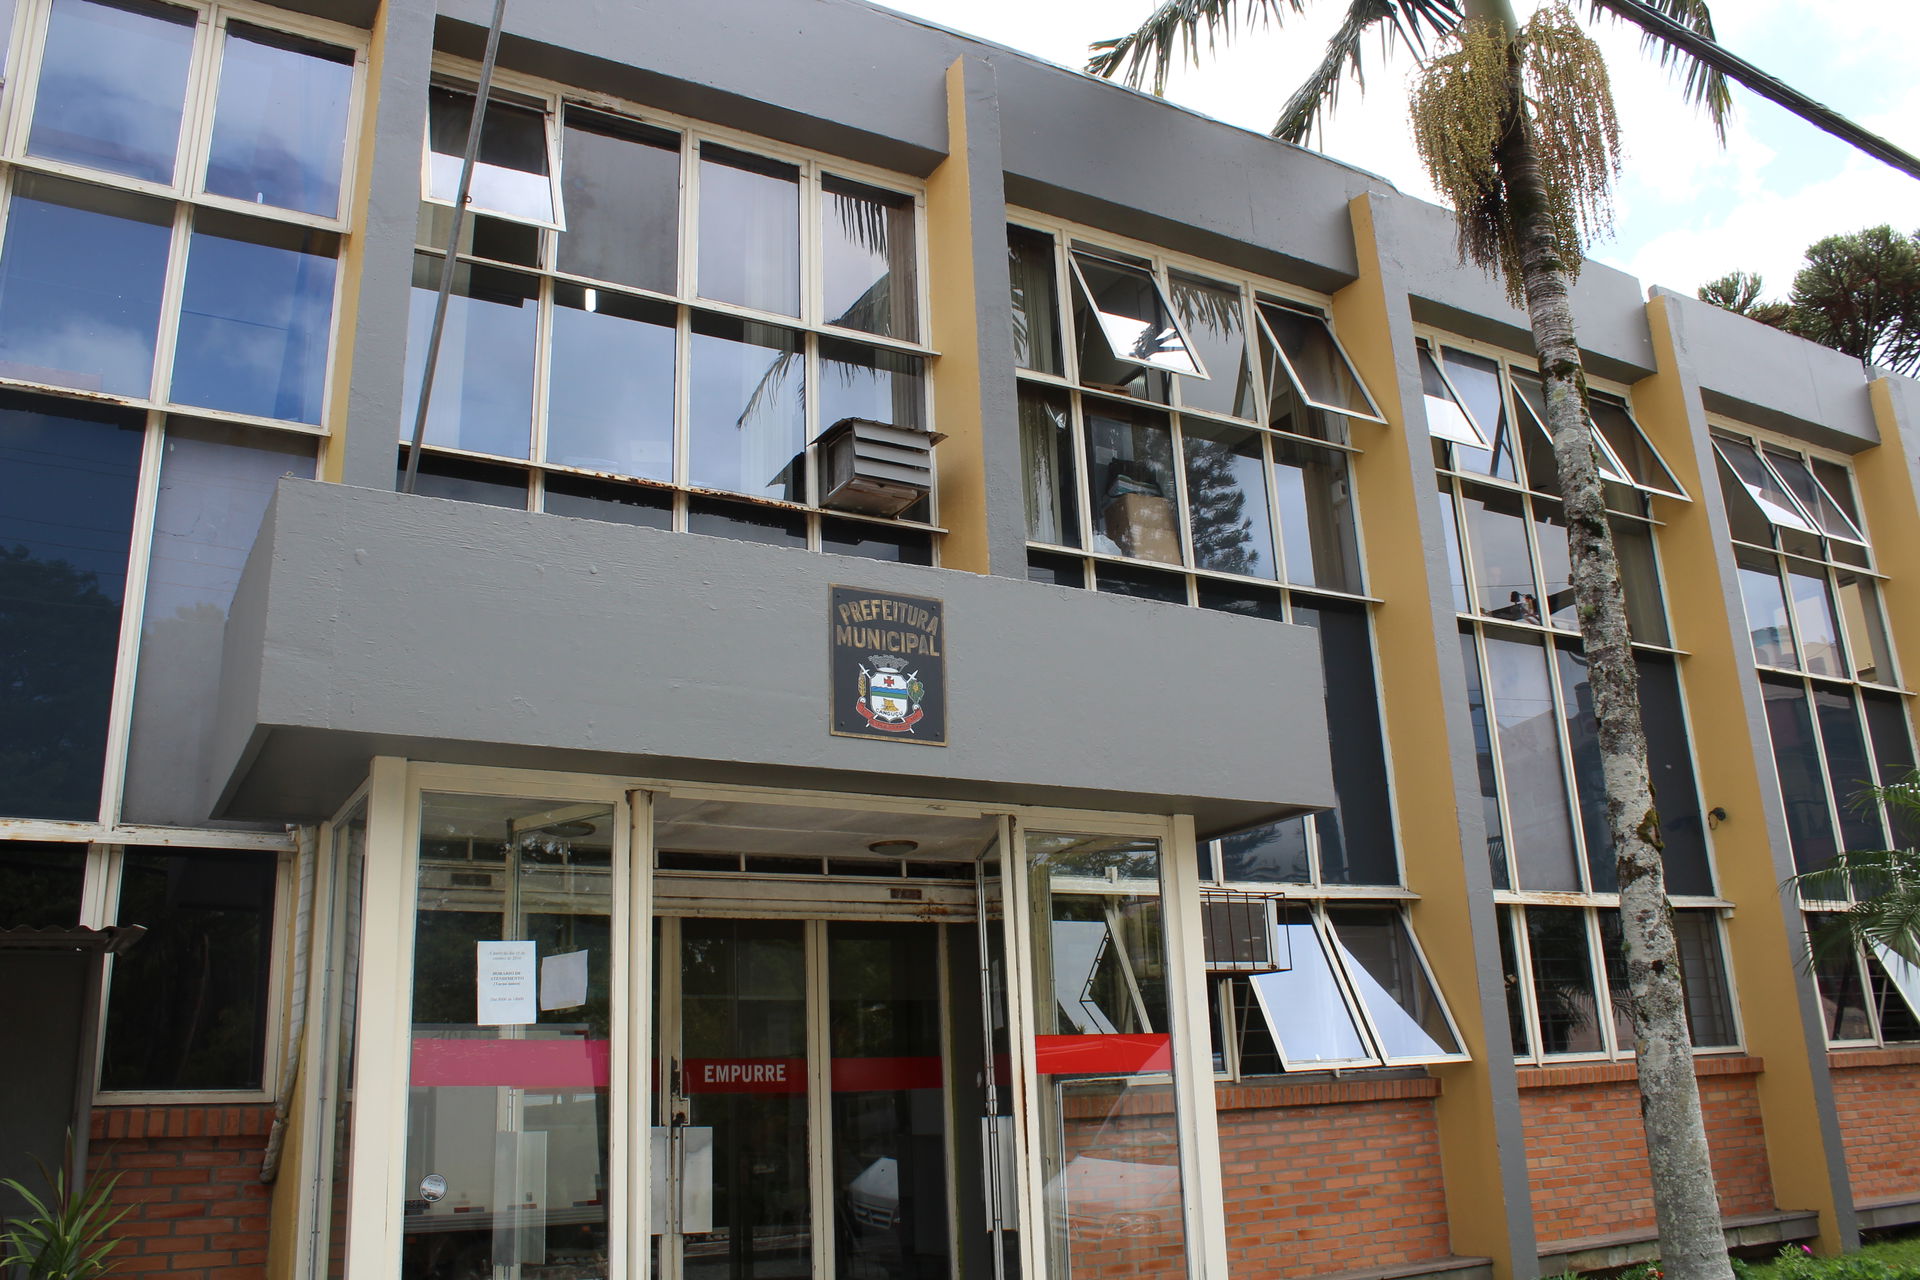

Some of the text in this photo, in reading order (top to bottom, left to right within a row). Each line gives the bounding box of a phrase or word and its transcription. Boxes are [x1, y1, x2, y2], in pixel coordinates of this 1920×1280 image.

[838, 599, 939, 636] PREFEITURA
[836, 624, 940, 657] MUNICIPAL
[704, 1064, 787, 1083] EMPURRE
